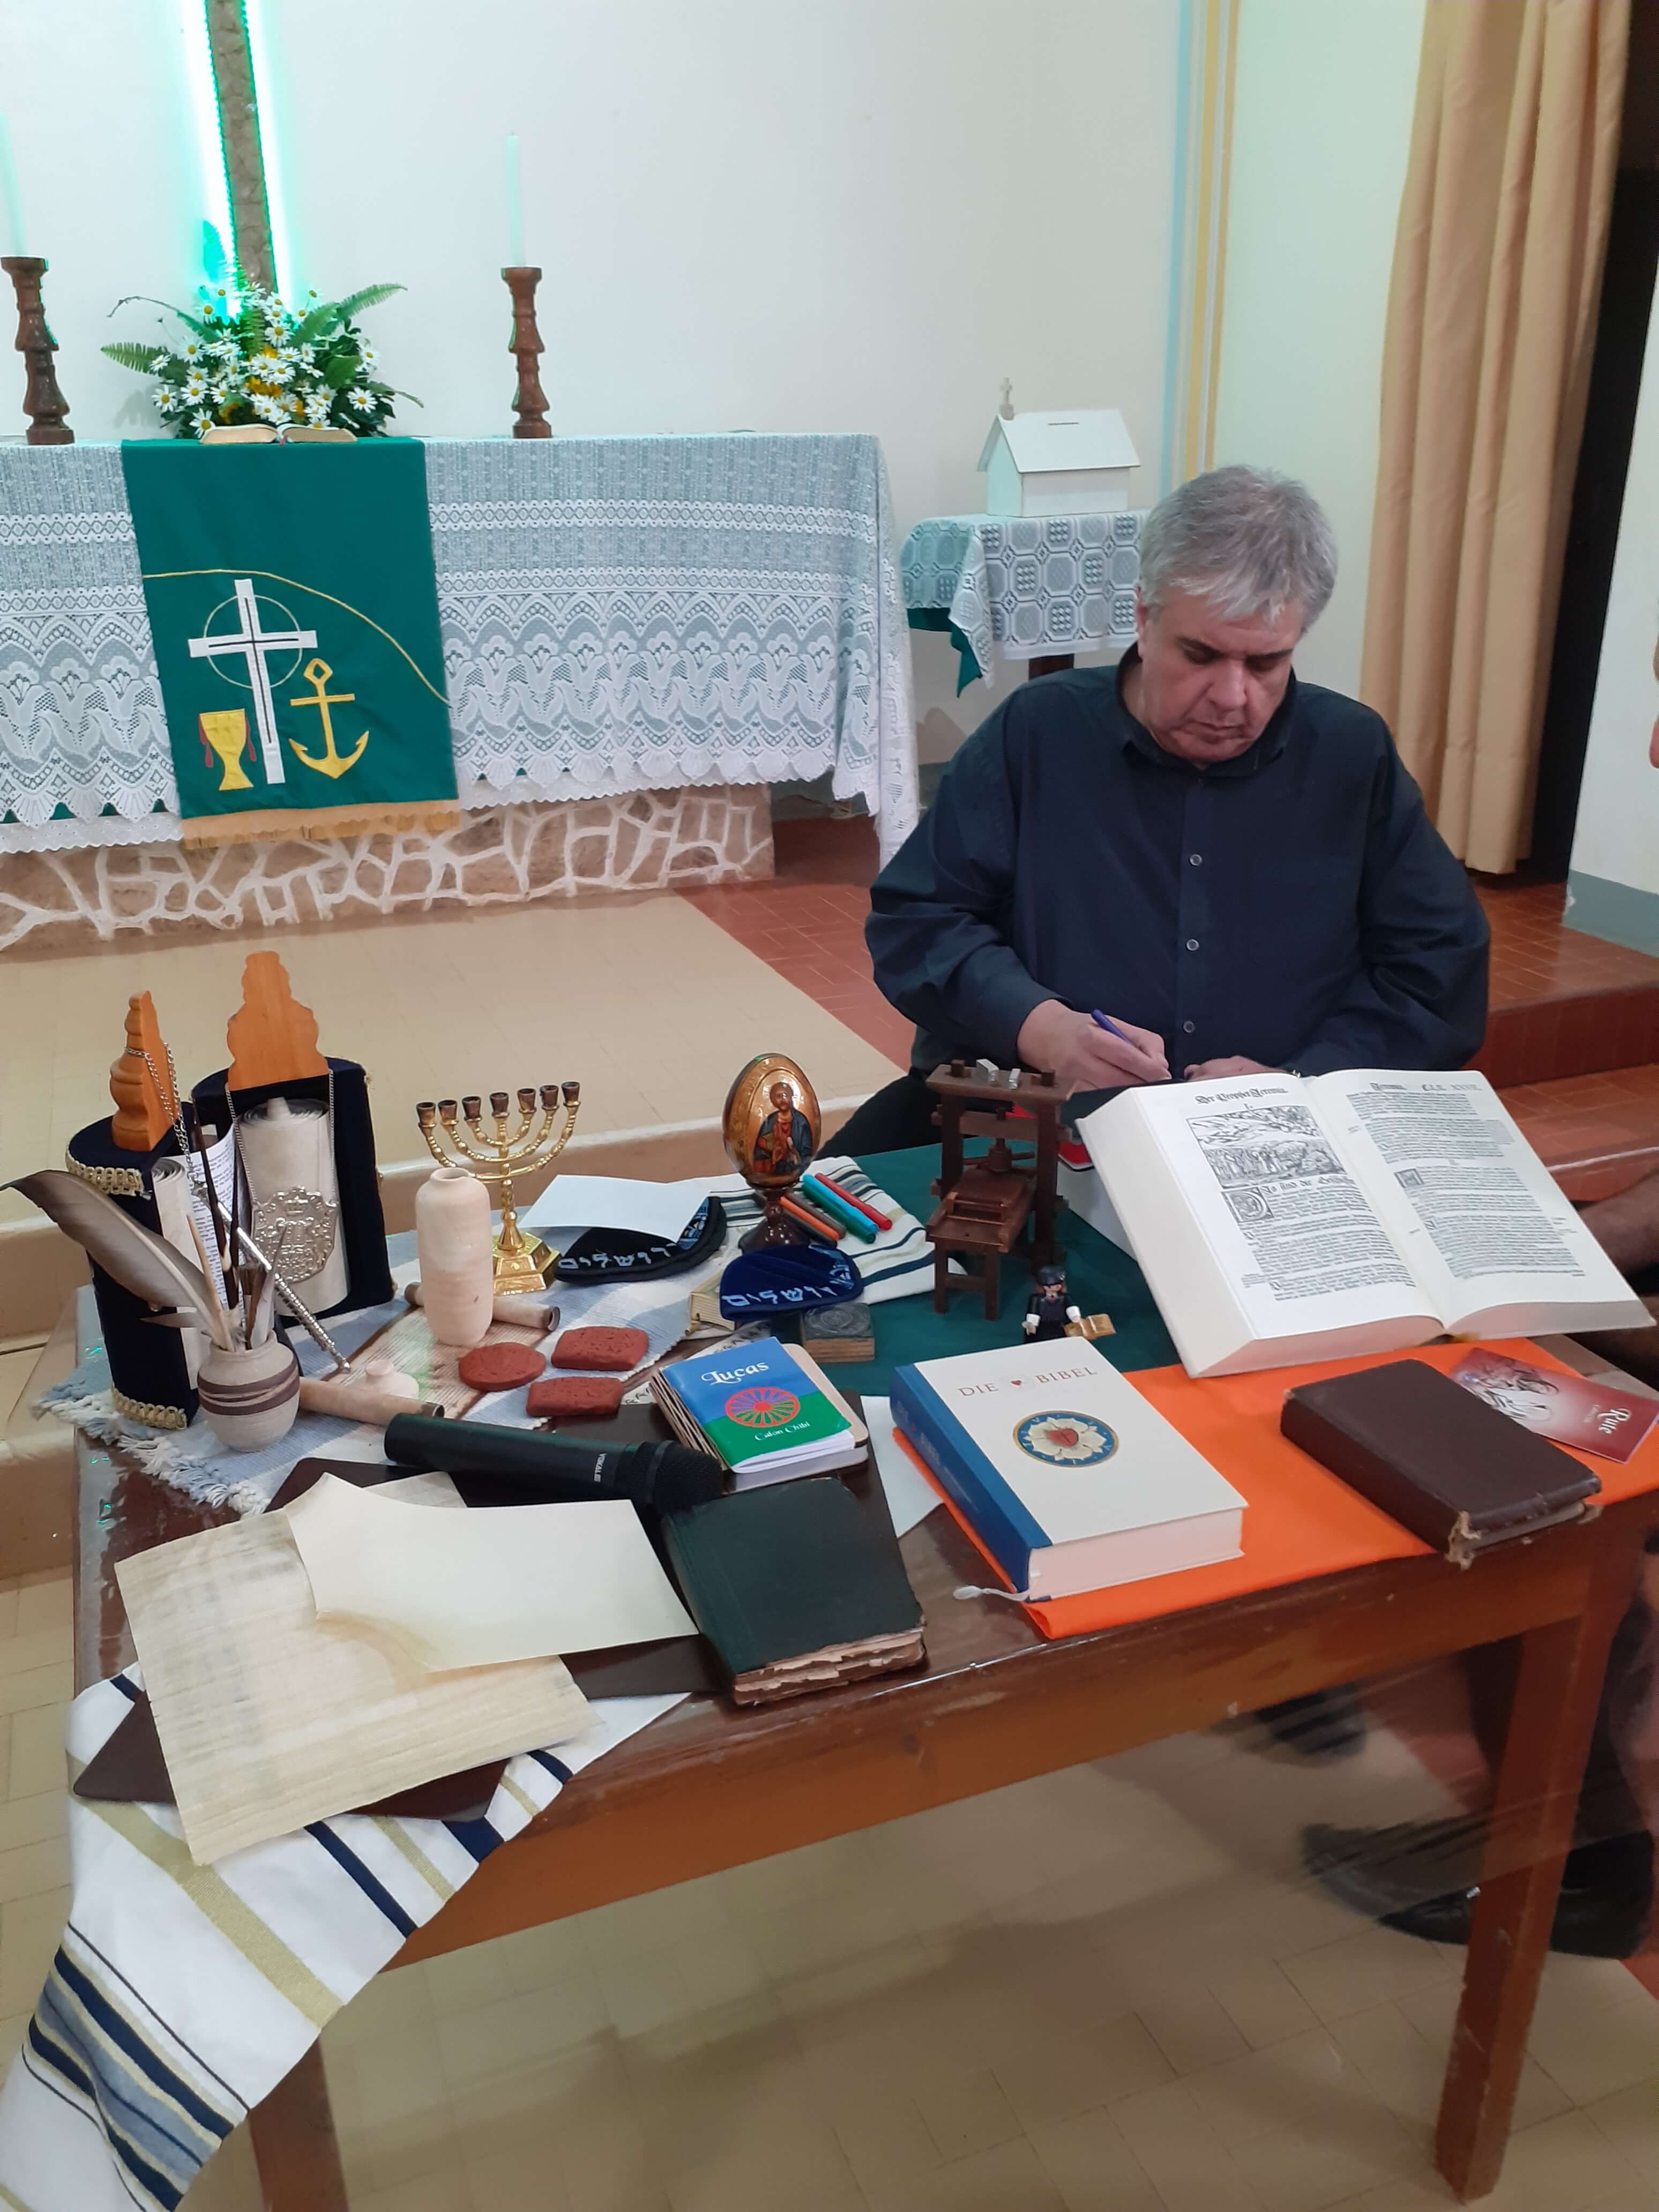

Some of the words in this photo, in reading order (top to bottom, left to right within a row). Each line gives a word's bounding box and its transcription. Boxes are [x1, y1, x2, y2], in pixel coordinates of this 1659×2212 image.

[701, 1362, 769, 1386] Lucas
[959, 1382, 998, 1396] DIE
[1036, 1366, 1098, 1384] BIBEL
